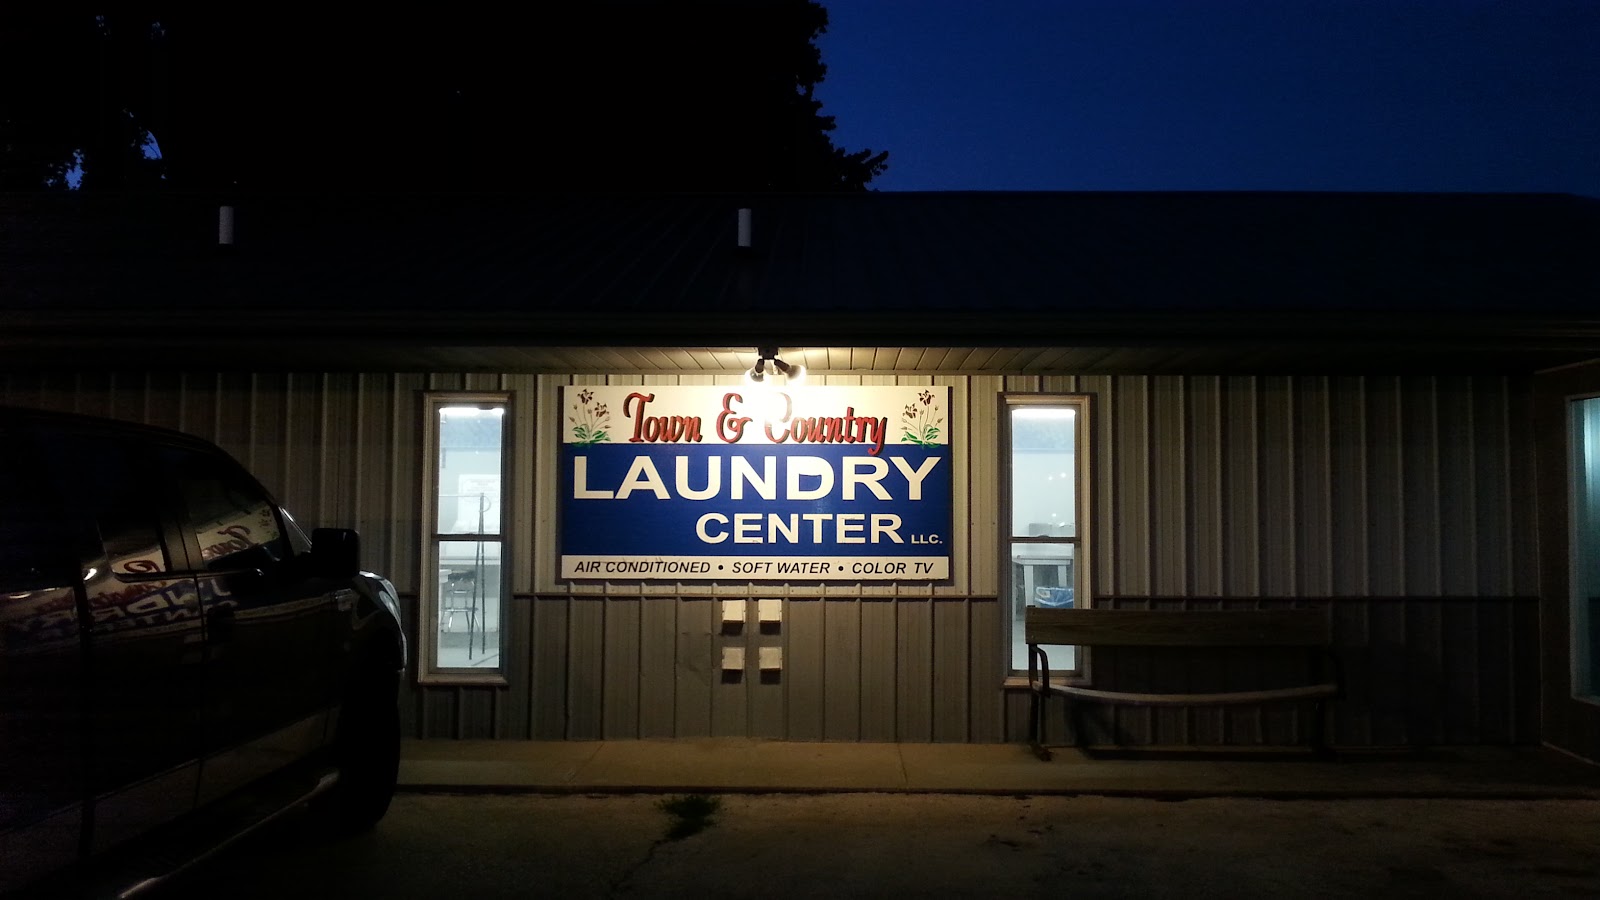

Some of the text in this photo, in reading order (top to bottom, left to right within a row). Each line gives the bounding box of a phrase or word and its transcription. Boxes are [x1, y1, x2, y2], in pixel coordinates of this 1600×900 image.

[623, 392, 888, 455] Town & Country
[574, 456, 941, 500] LAUNDRY
[696, 513, 943, 545] CENTER LLC.
[574, 561, 934, 575] AIR CONDITIONED SOFT WATER COLOR TV
